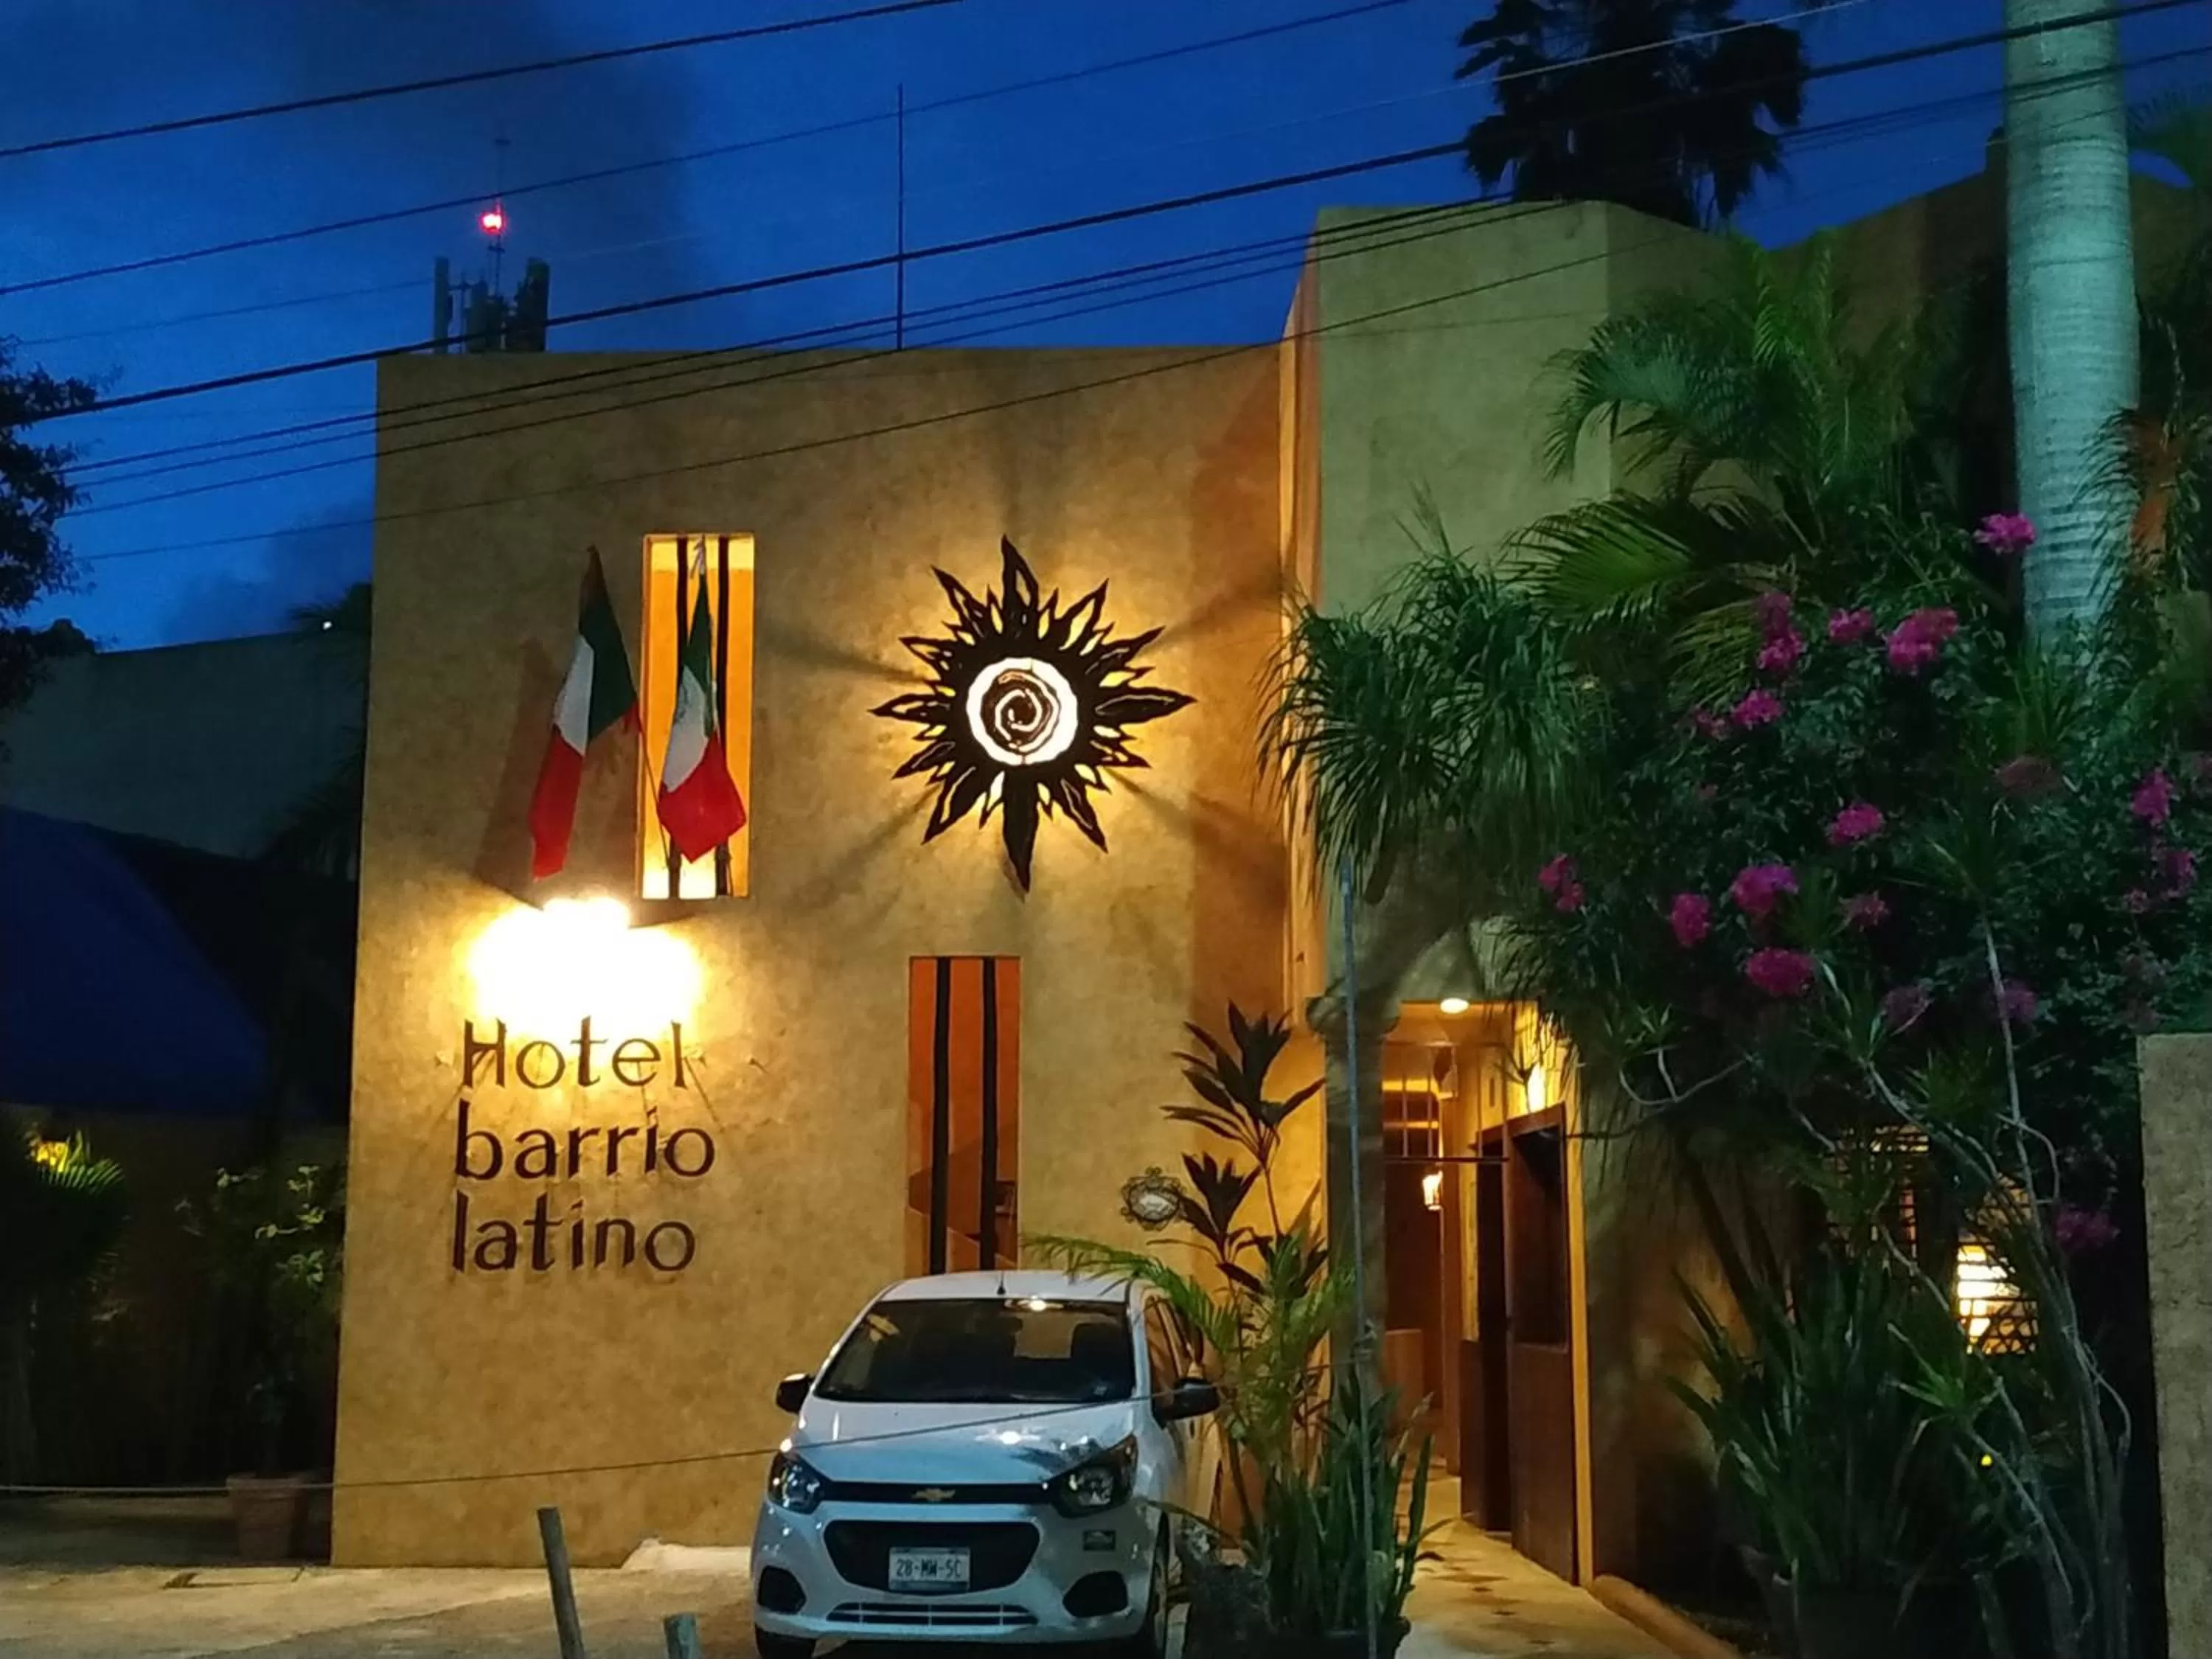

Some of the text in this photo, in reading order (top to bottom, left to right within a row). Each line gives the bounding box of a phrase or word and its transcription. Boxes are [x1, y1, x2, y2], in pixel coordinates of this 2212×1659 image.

[462, 1015, 688, 1089] Hotel
[454, 1097, 715, 1180] barrio
[452, 1189, 696, 1273] latino
